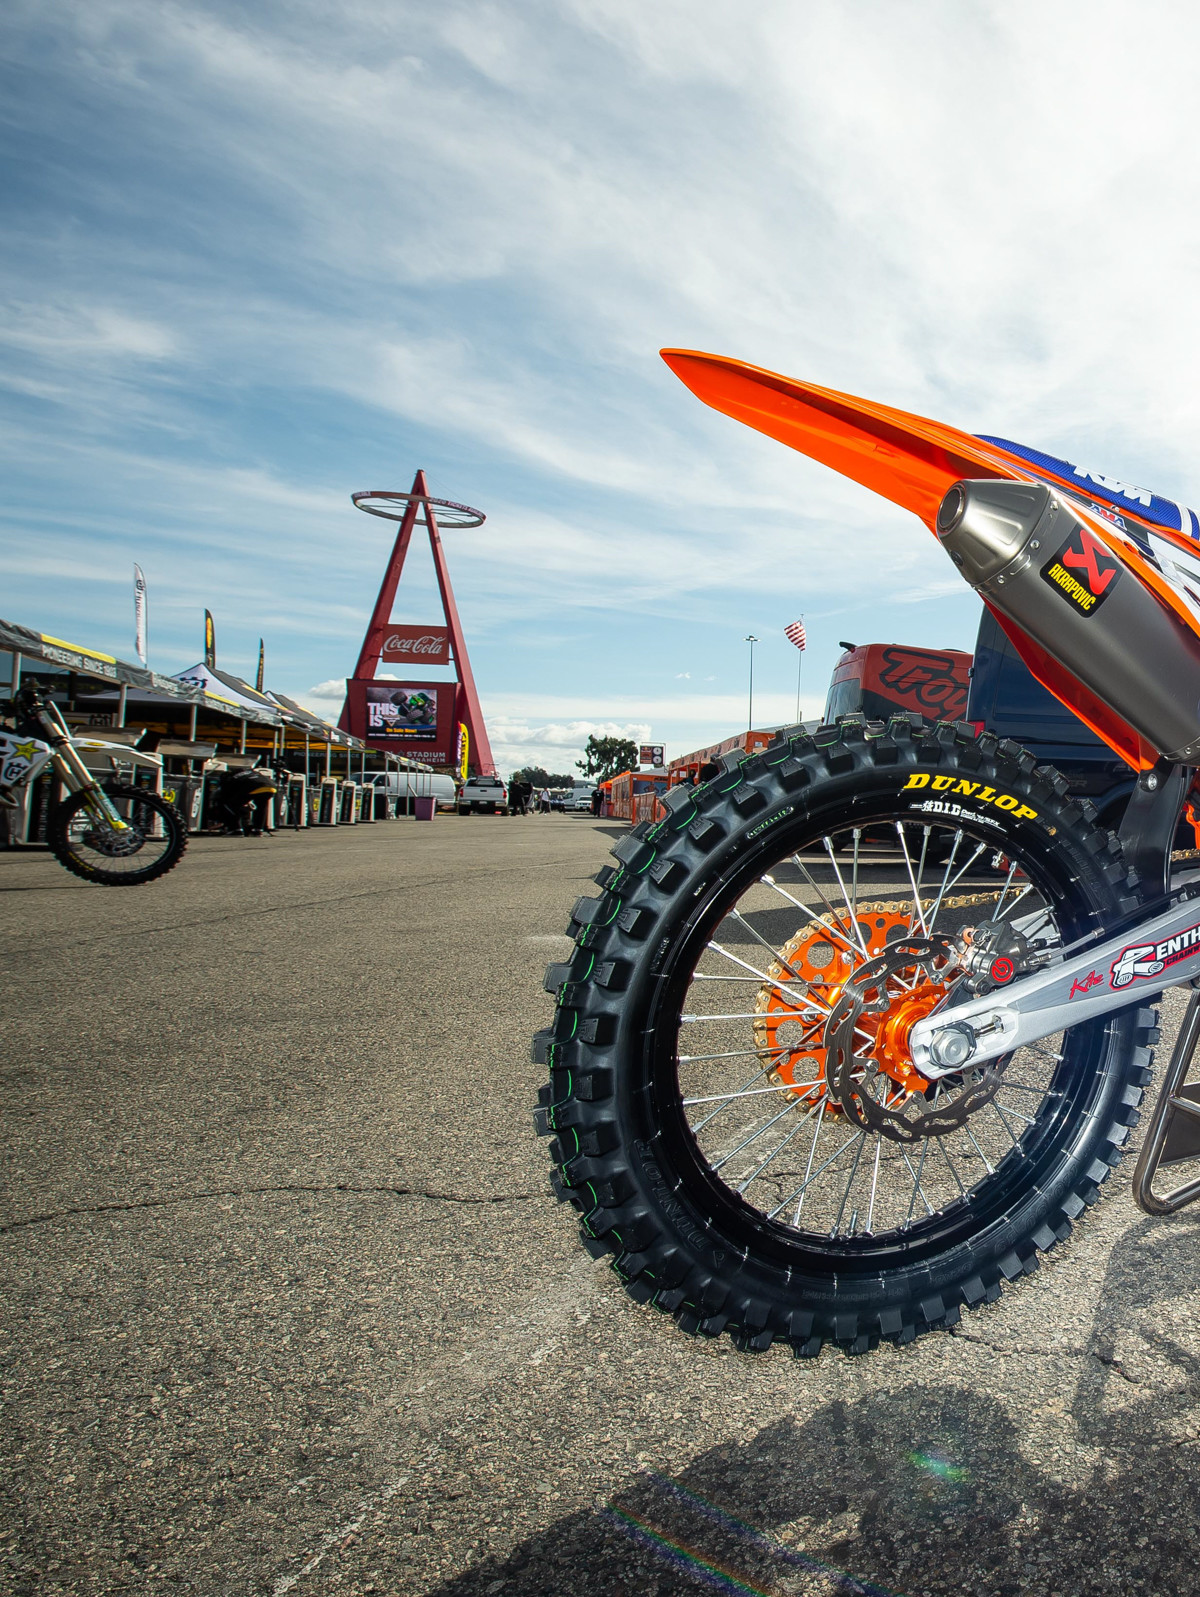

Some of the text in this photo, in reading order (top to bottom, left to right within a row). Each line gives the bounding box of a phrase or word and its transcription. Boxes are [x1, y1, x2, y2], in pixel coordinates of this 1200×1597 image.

[1088, 503, 1127, 532] AMA
[383, 634, 447, 654] Coca-Cola
[41, 643, 82, 669] PIONEERING
[83, 657, 104, 673] SINCE
[367, 702, 398, 715] THIS
[369, 714, 384, 727] IS
[903, 773, 1039, 820] DUNLOP
